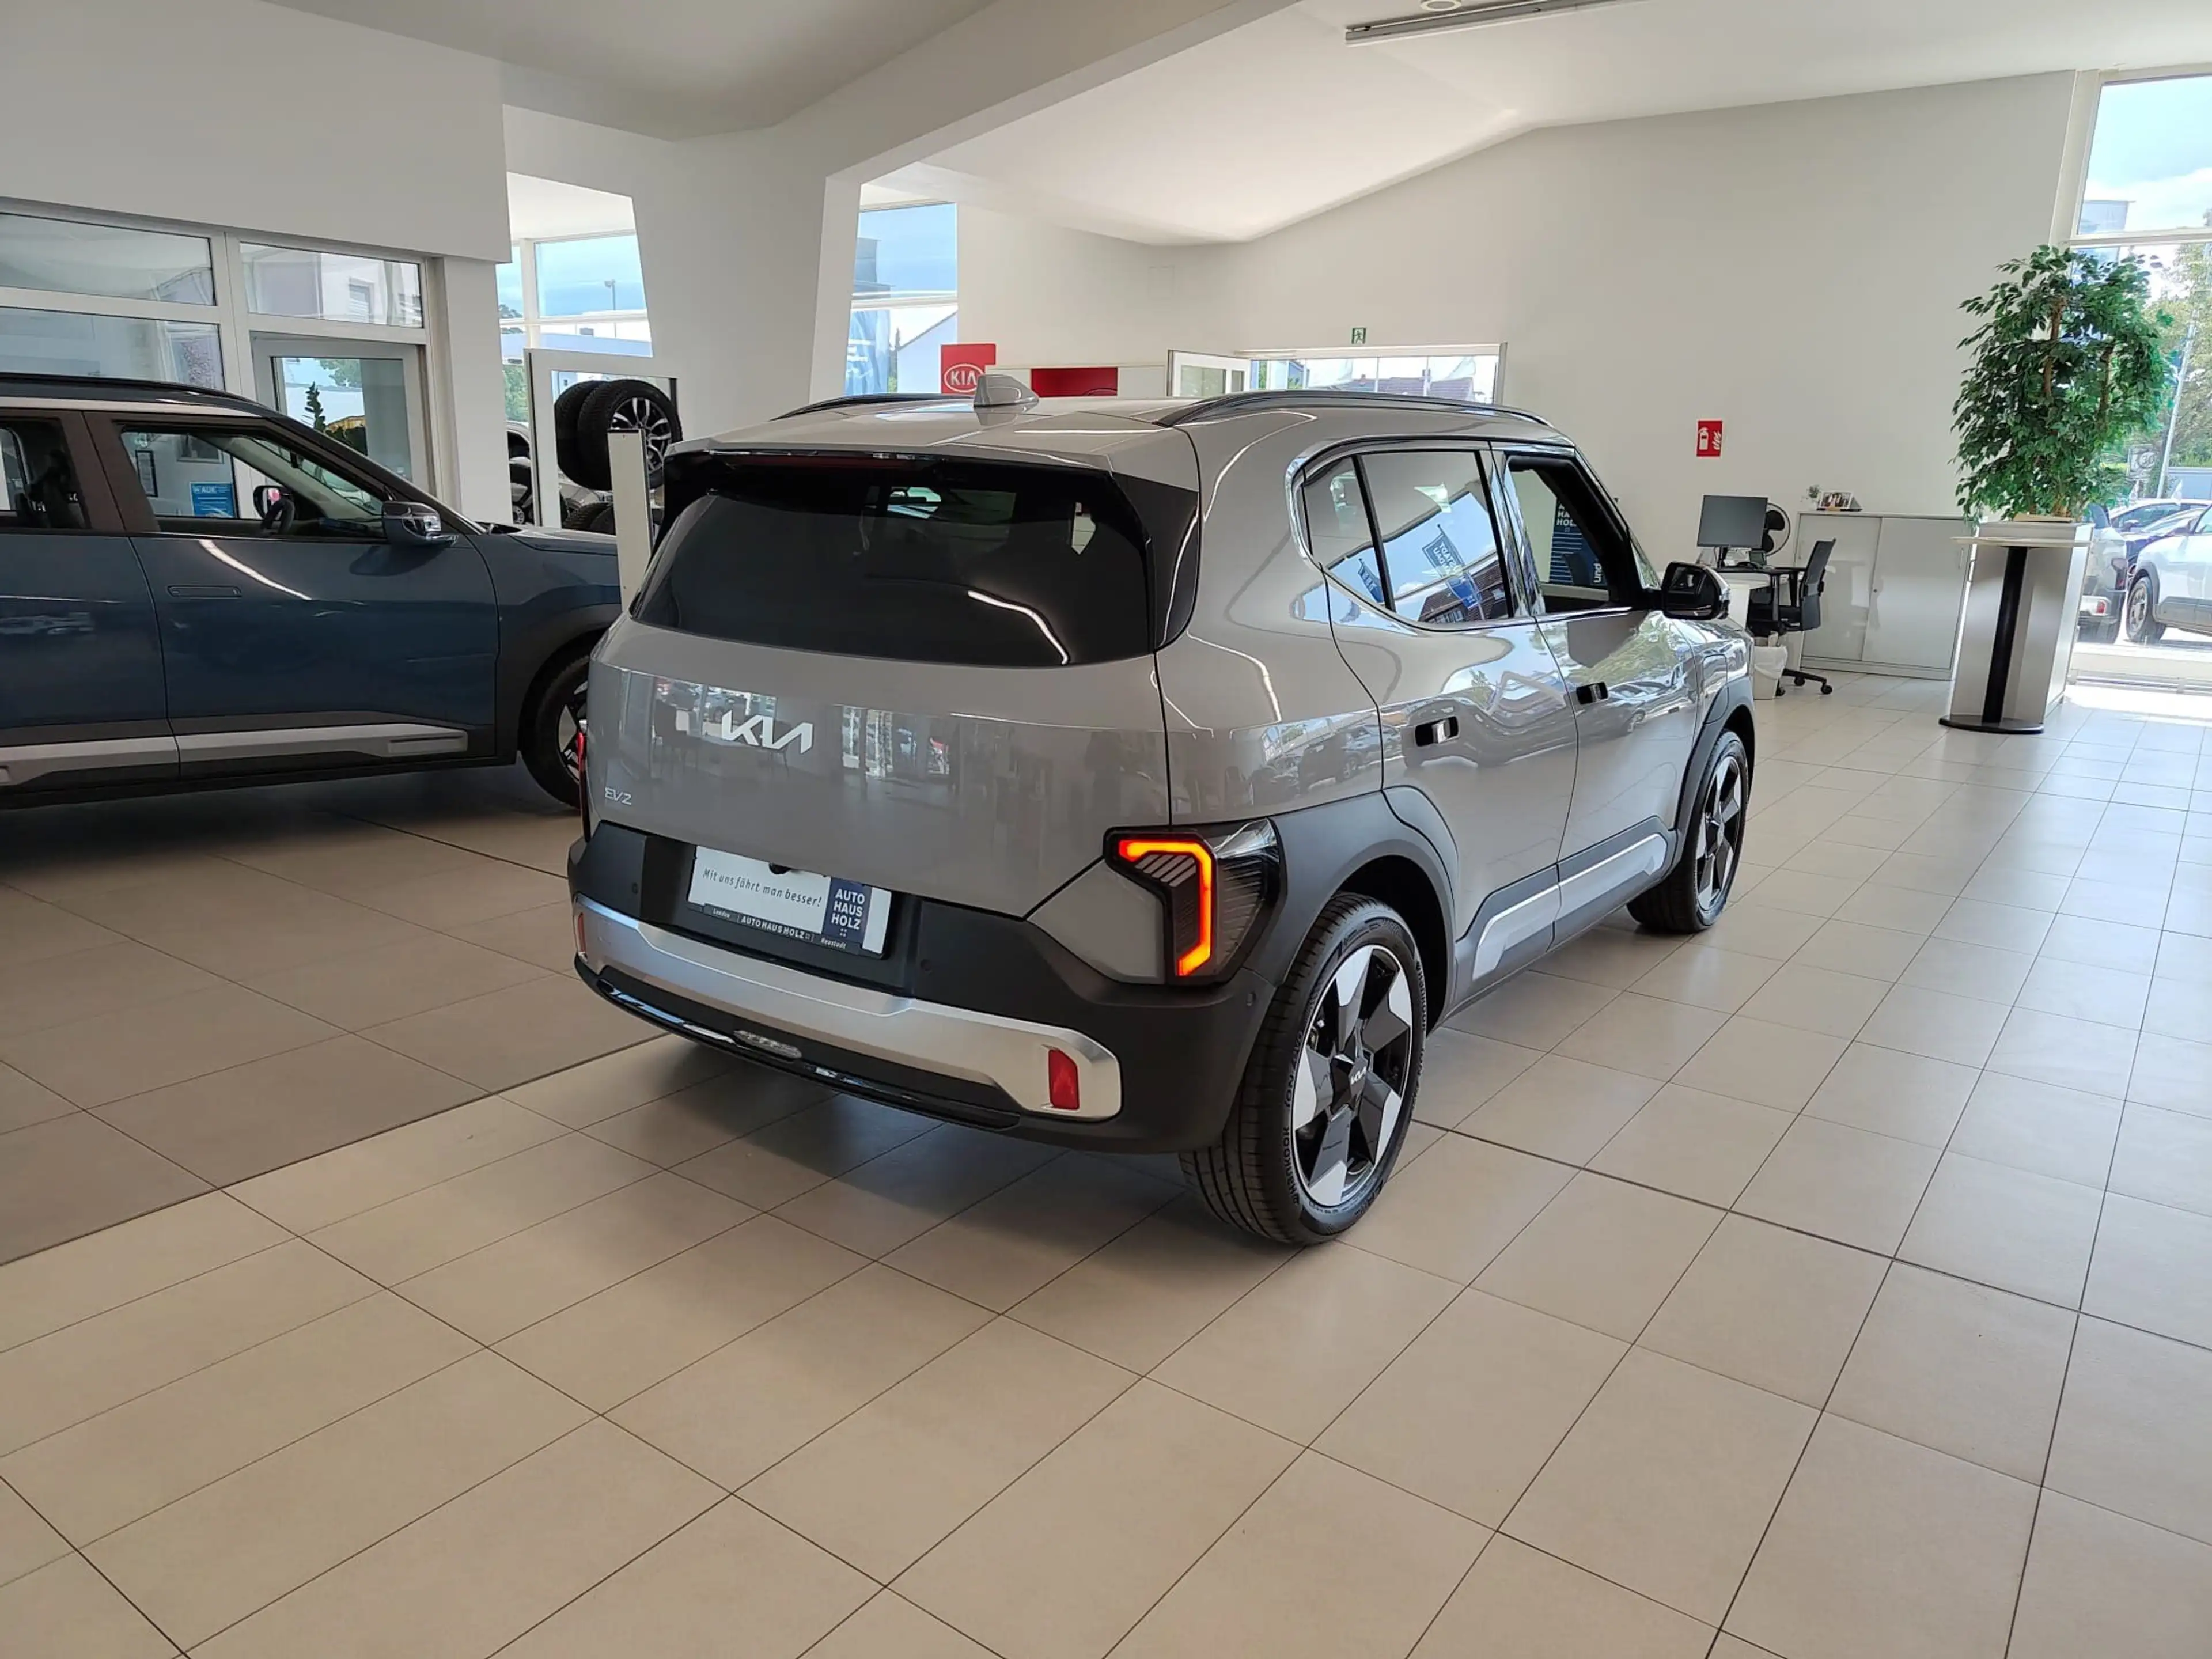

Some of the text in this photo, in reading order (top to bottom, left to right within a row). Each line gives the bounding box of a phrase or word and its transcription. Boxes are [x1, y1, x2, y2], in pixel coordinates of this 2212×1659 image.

[950, 370, 977, 385] KIA
[721, 710, 813, 754] KIA
[605, 787, 632, 805] EV2
[703, 868, 823, 907] Mit uns fährt man besser!
[835, 888, 865, 905] AUTO
[834, 900, 863, 918] HAUS
[831, 913, 861, 930] HOLZ
[1351, 1066, 1367, 1085] KIA
